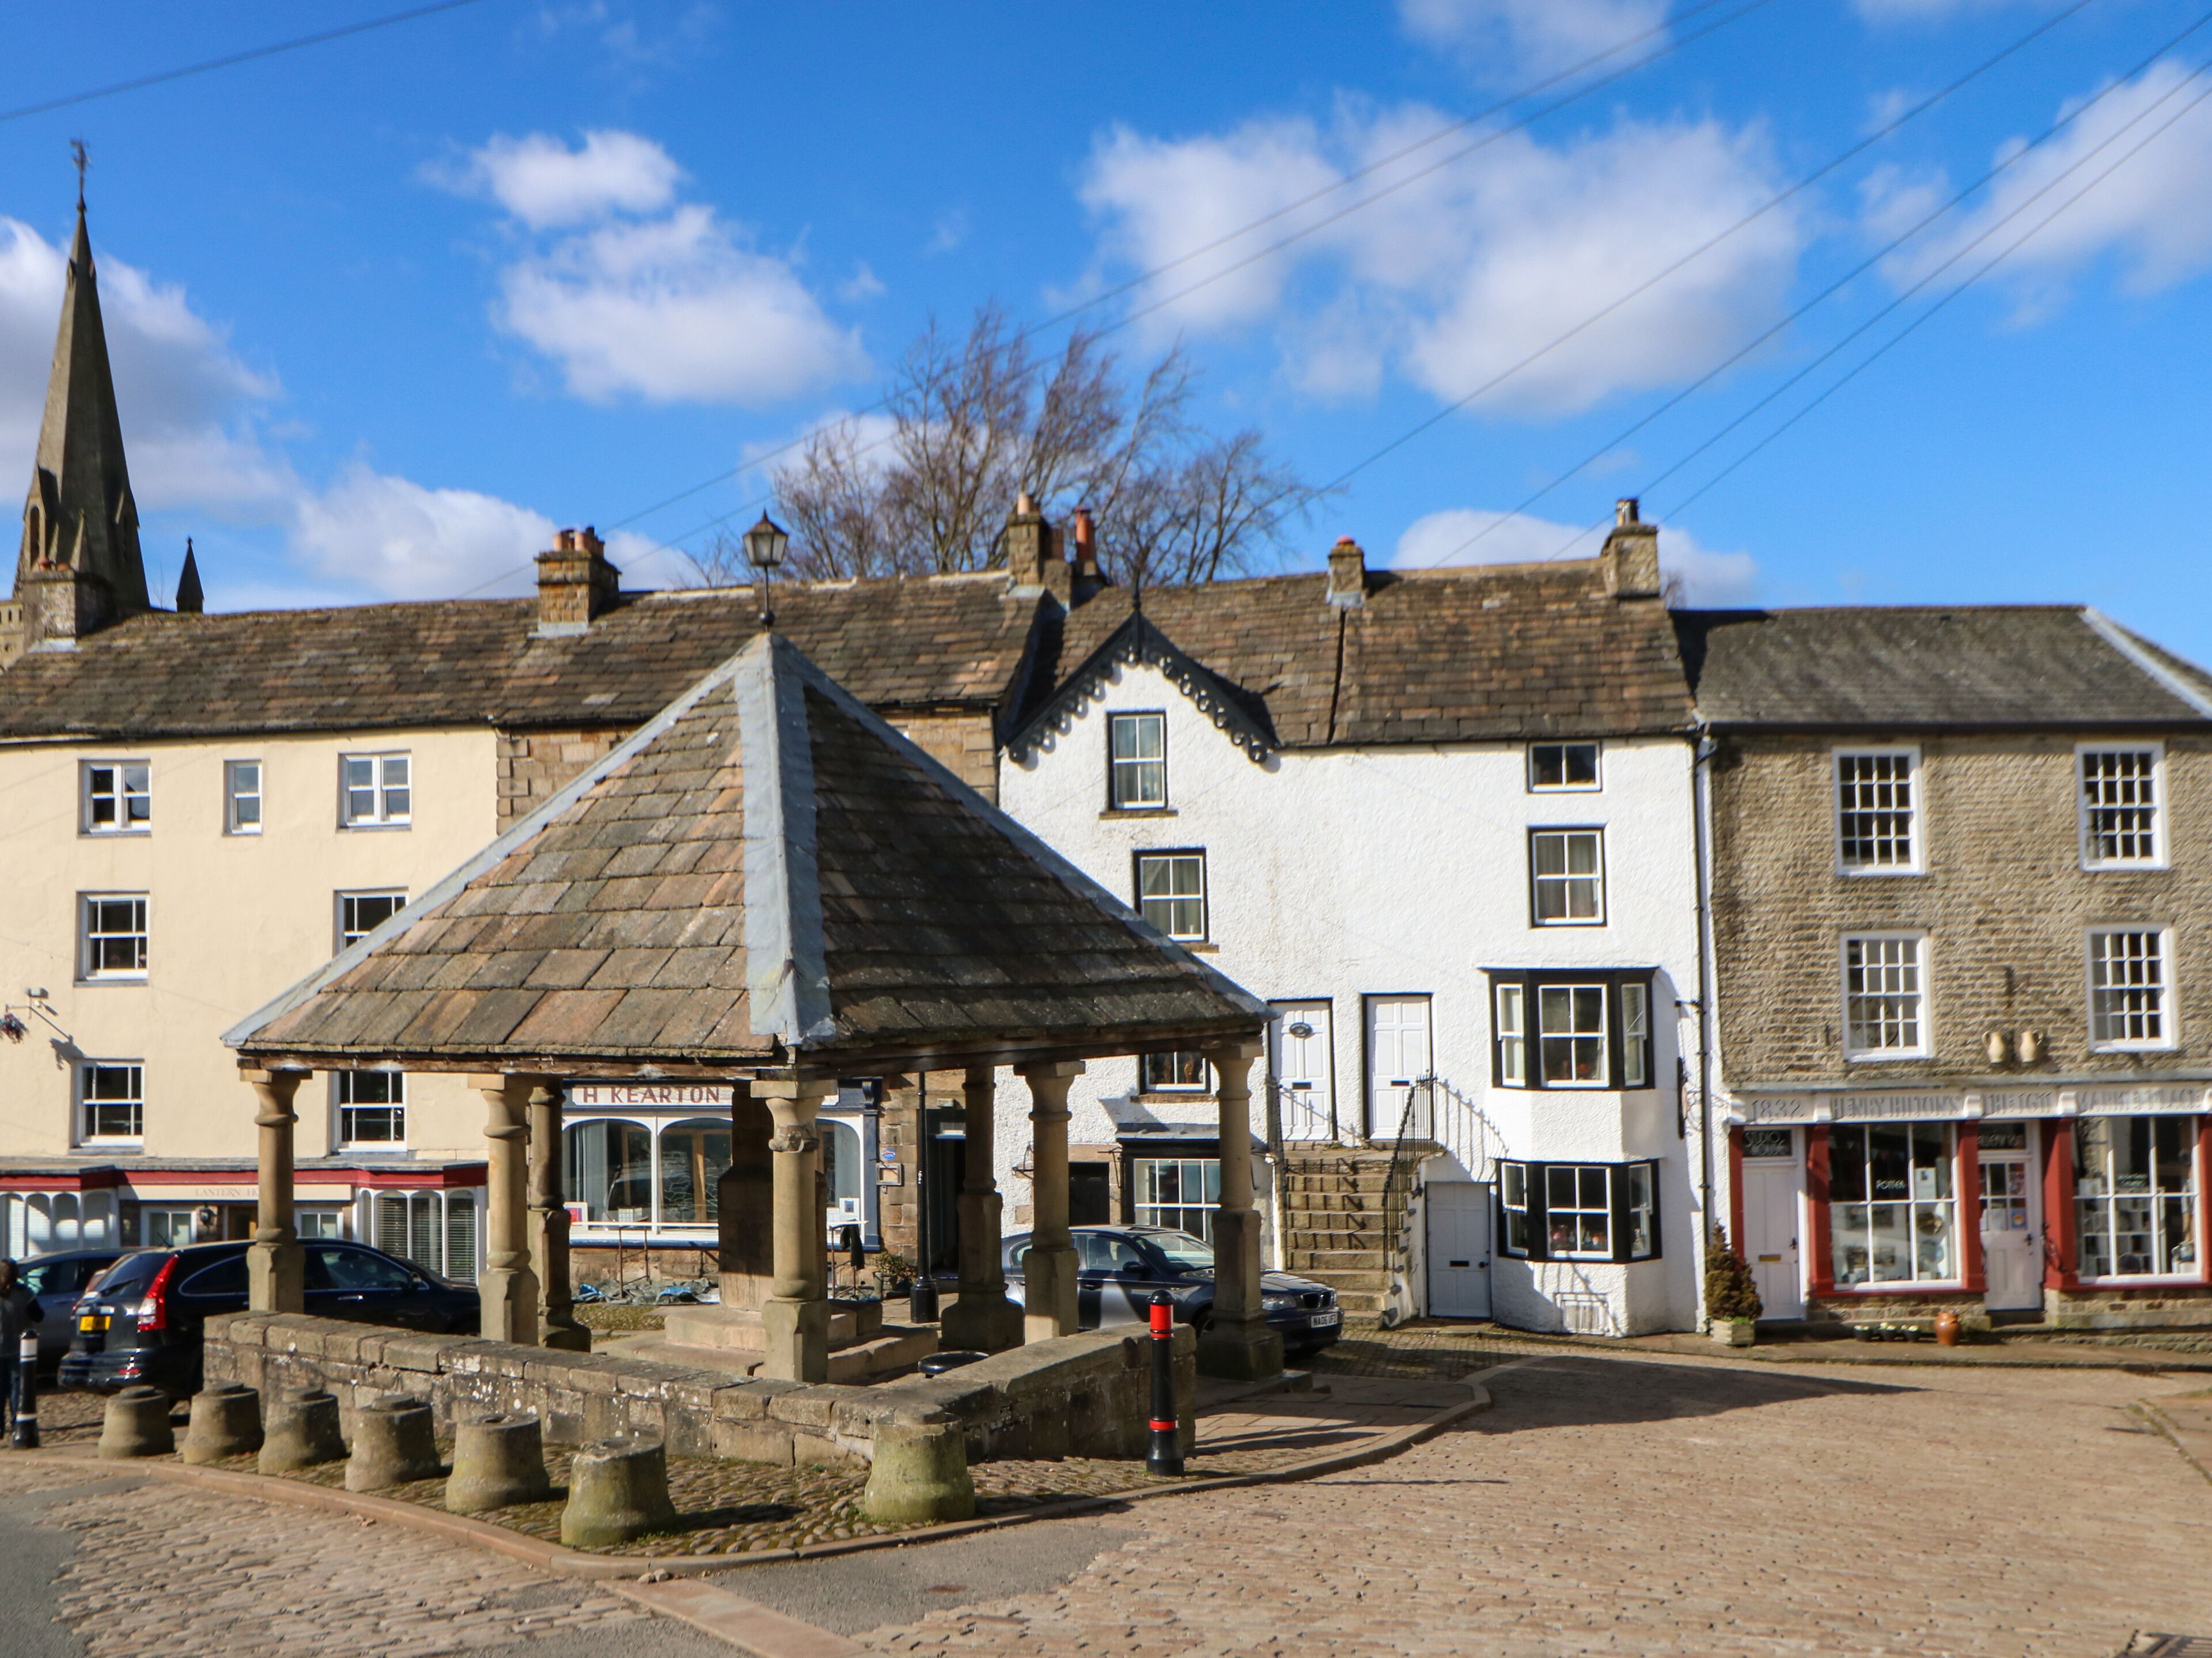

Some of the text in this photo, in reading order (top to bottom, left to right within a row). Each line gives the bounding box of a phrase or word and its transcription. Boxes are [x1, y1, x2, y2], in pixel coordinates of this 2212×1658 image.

[583, 1086, 720, 1103] H KEARTON
[1751, 1098, 1804, 1121] 1832
[195, 1187, 241, 1197] LANTERN
